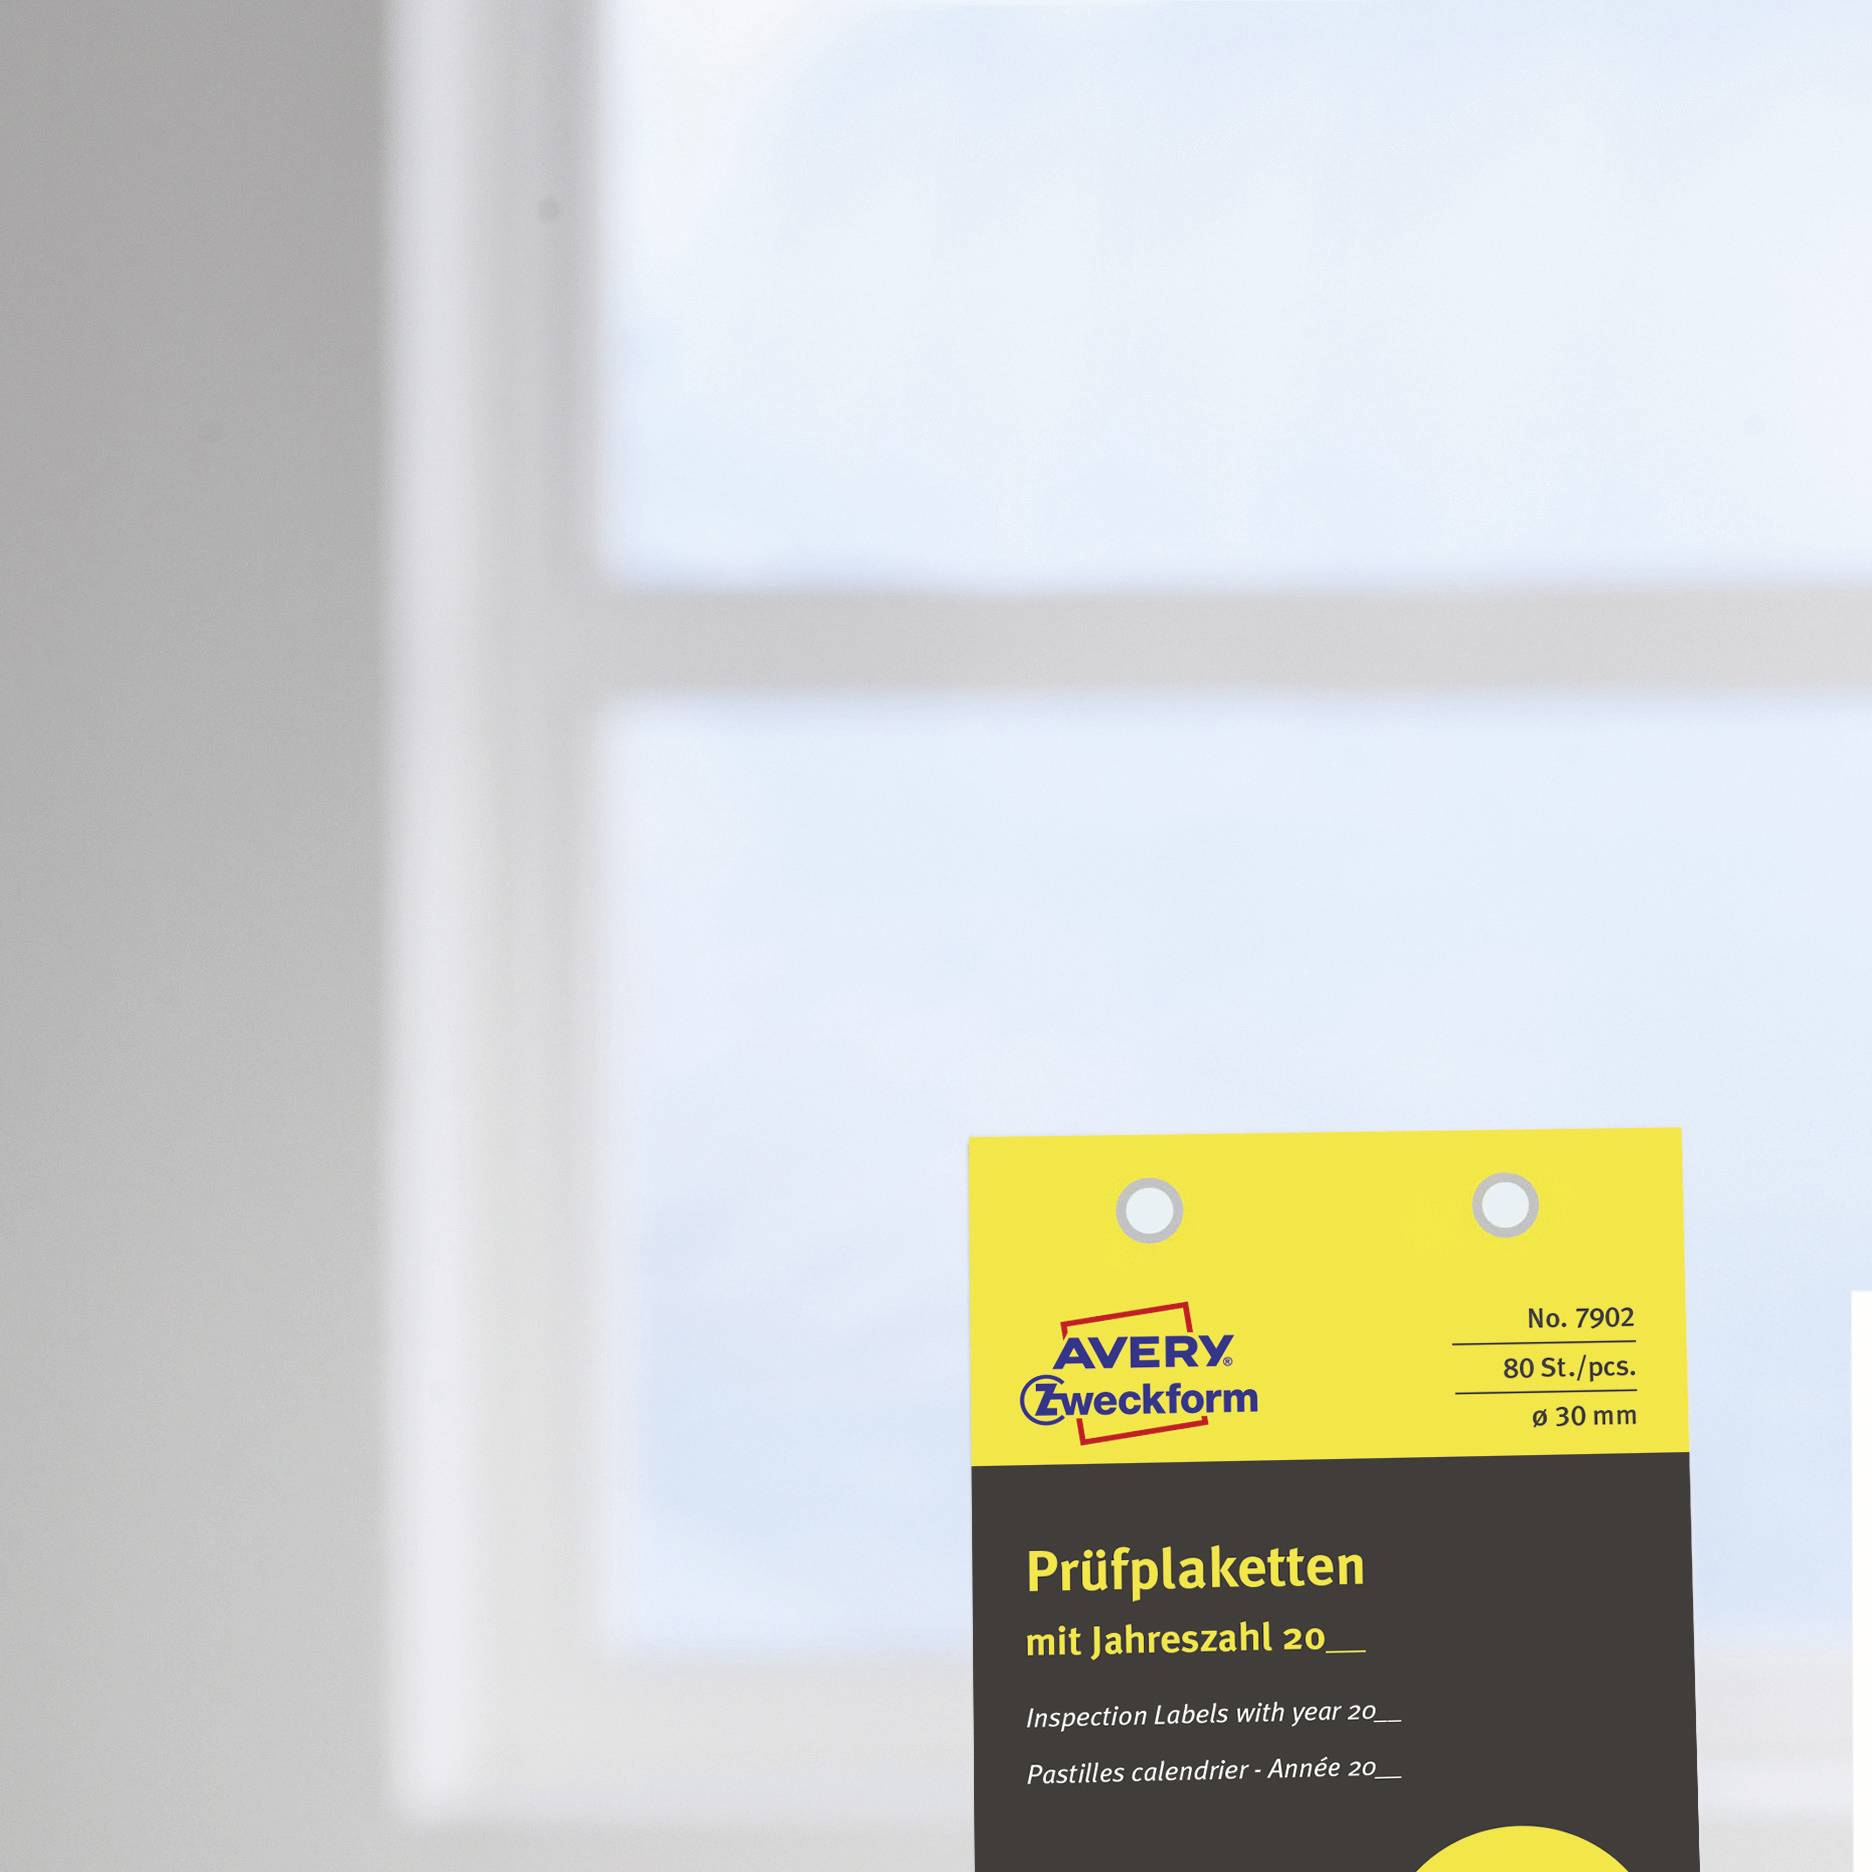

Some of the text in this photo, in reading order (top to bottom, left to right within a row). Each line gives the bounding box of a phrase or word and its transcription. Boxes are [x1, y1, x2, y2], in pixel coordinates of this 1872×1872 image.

[1528, 1306, 1635, 1330] No. 7902
[1503, 1354, 1637, 1384] 80 St./pcs.
[1020, 1374, 1259, 1426] Zweckform
[1555, 1405, 1586, 1428] 30
[1593, 1408, 1638, 1427] mm
[1027, 1544, 1365, 1603] Prüfplaketten
[1025, 1624, 1082, 1657] mit
[1090, 1620, 1273, 1661] Jahreszahl
[1026, 1704, 1147, 1730] Inspection
[1154, 1701, 1229, 1726] Labels
[1236, 1700, 1285, 1724] with
[1291, 1704, 1343, 1728] year
[1026, 1760, 1125, 1786] Pastilles
[1131, 1758, 1251, 1783] calendrier
[1266, 1755, 1341, 1780] Année
